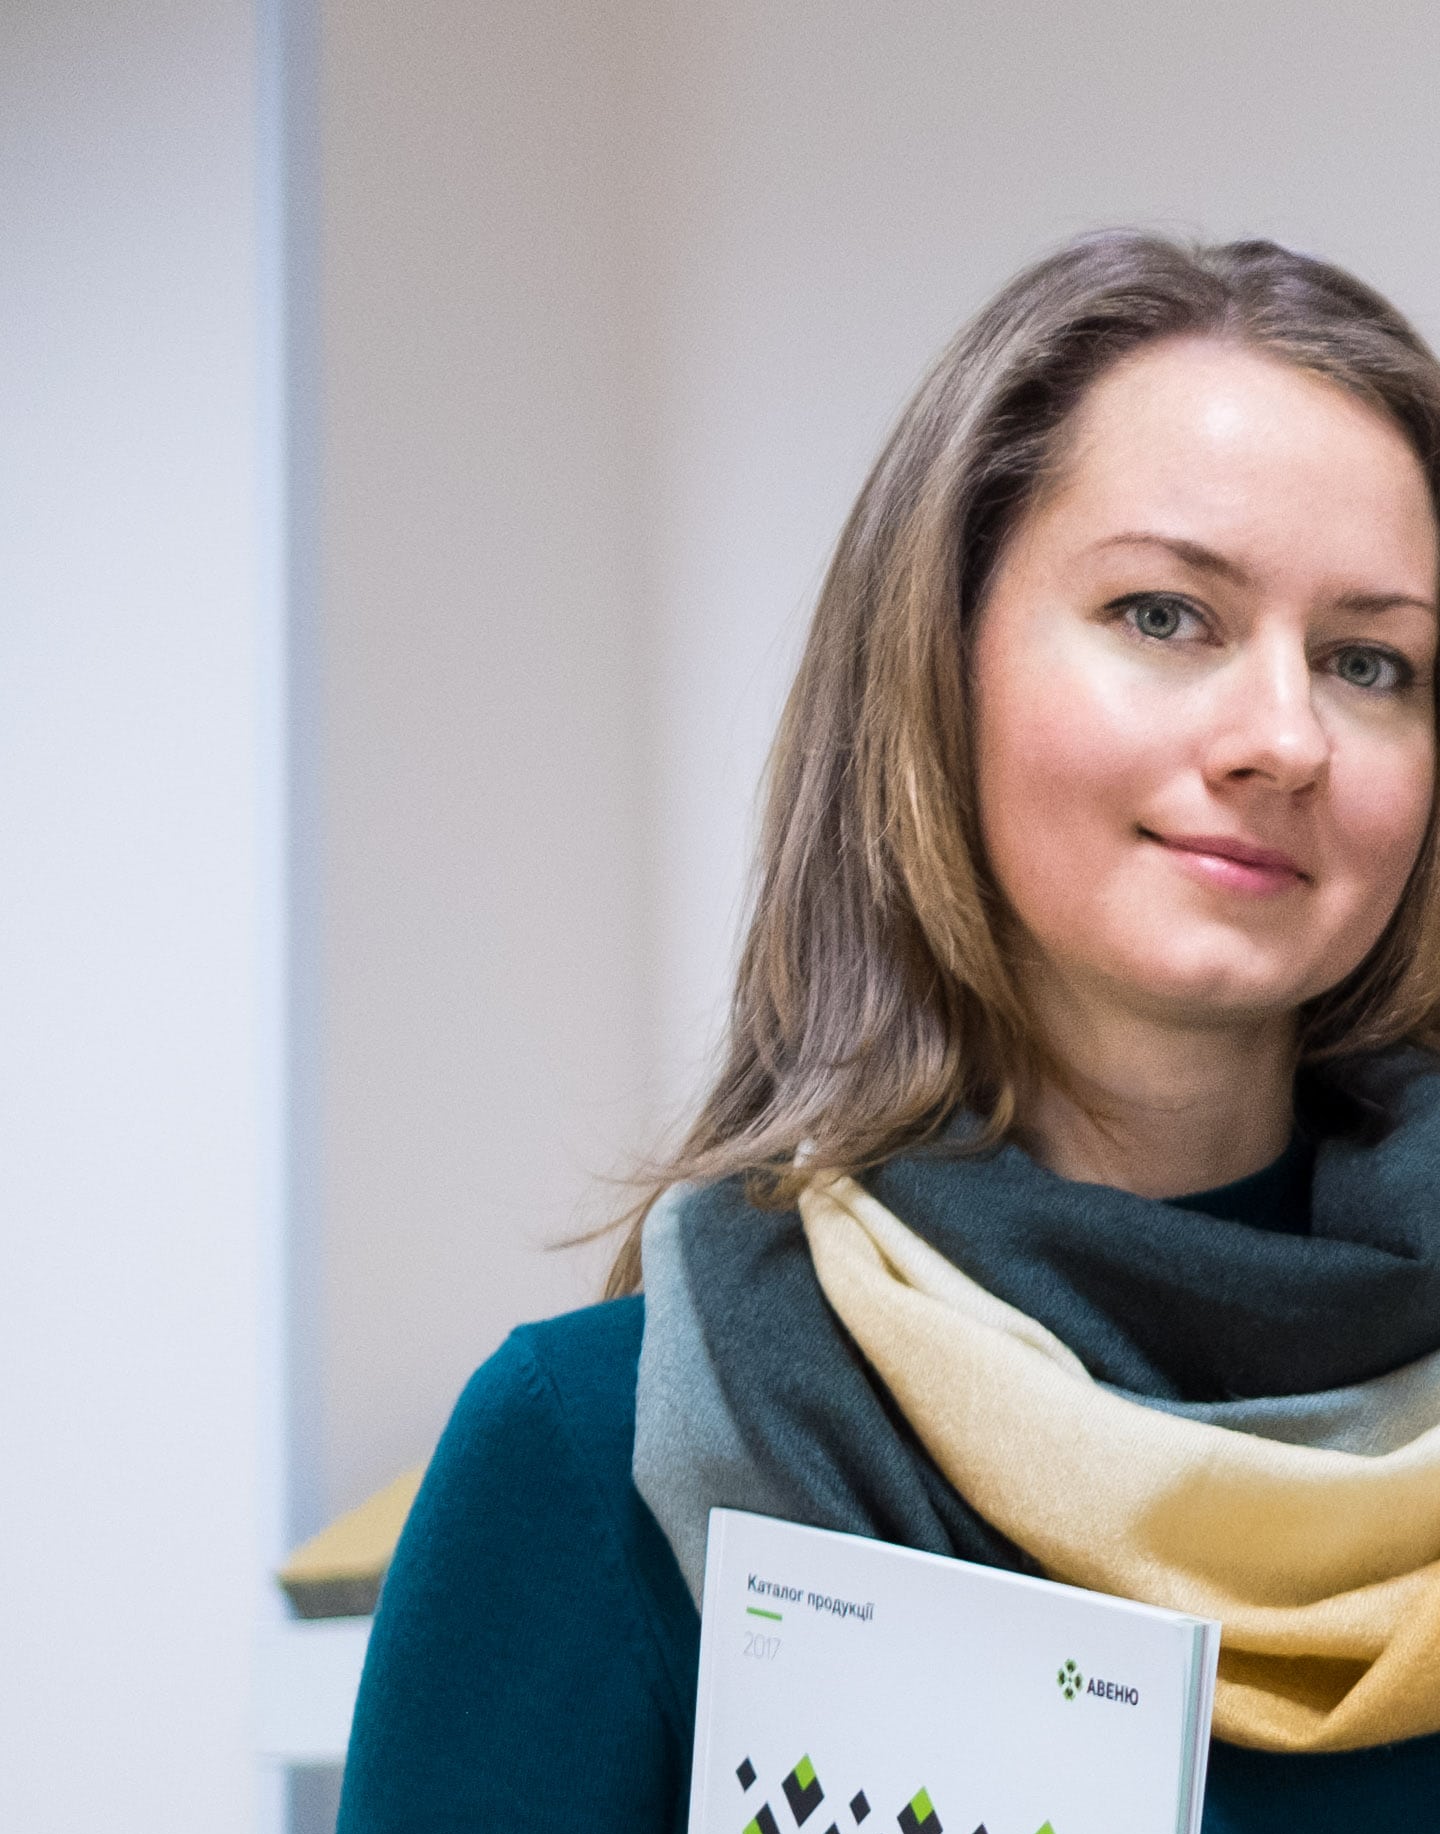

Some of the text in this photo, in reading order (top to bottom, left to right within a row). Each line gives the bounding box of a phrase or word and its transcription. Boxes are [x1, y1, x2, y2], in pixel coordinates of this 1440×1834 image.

[747, 1573, 874, 1621] Каталог продукції
[743, 1631, 782, 1661] 2017
[1087, 1677, 1139, 1706] АВЕНЮ
